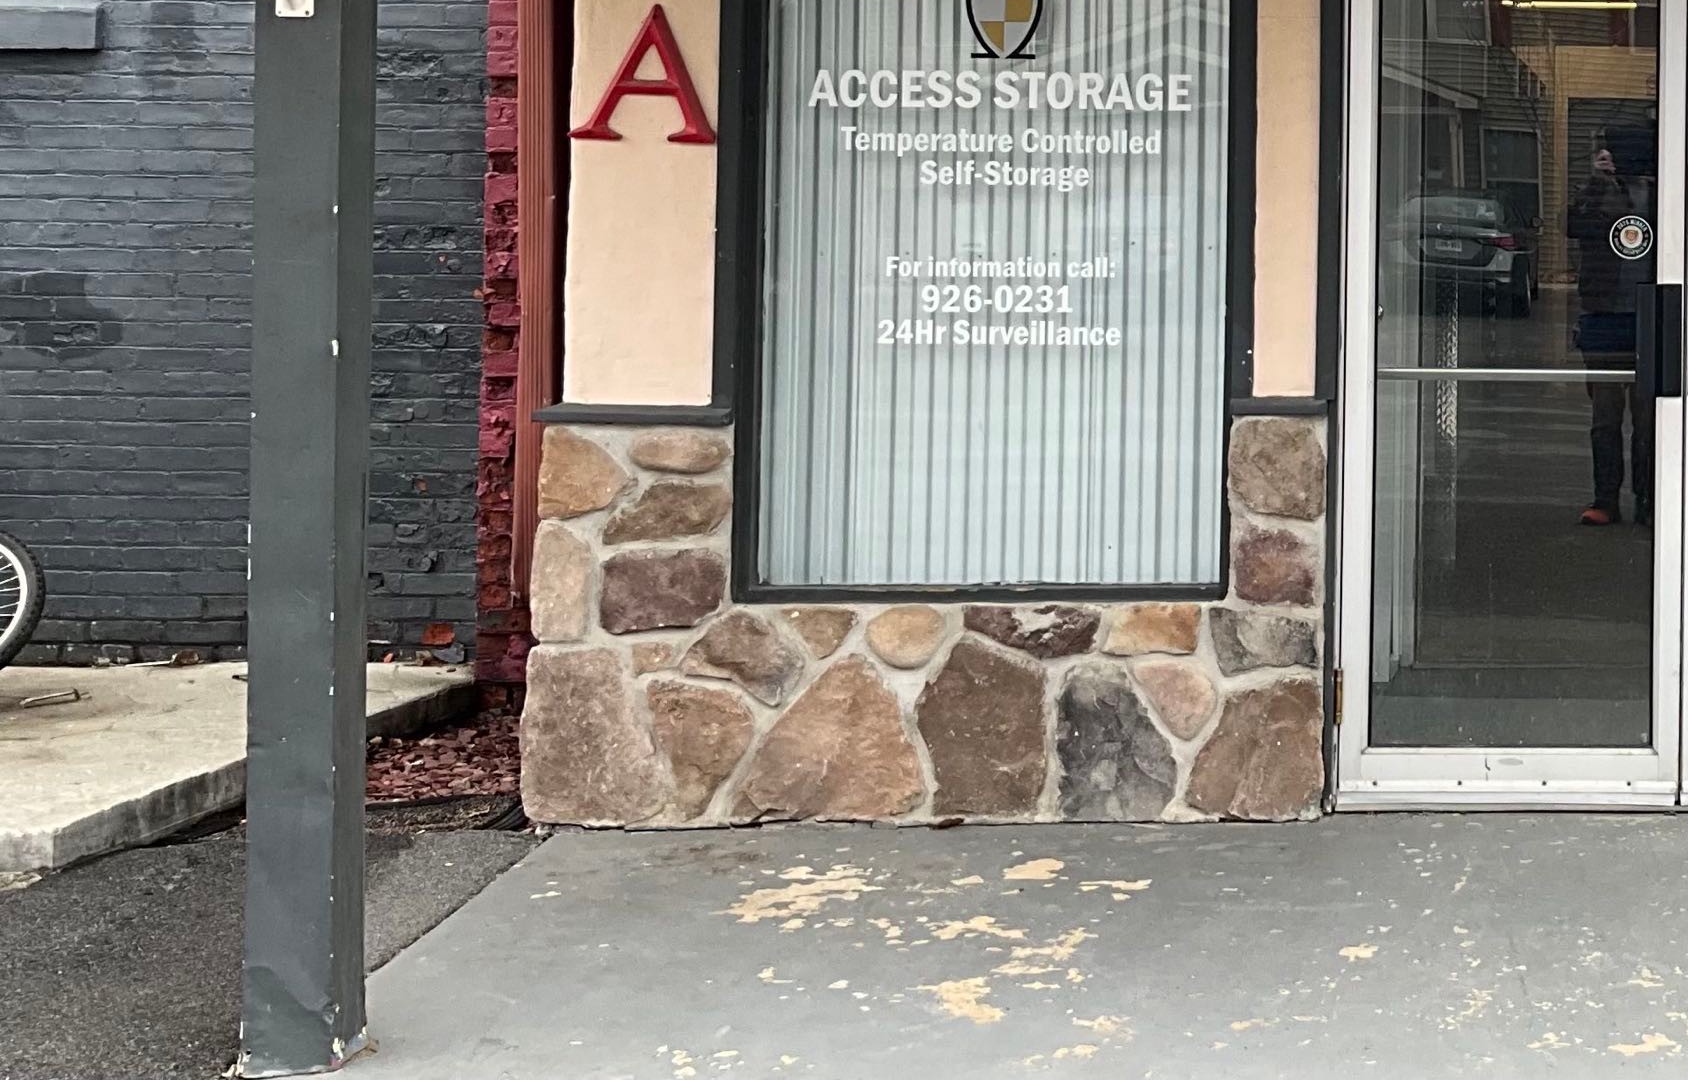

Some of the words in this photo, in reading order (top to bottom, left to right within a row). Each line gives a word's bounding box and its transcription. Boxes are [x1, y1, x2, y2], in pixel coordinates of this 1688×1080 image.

[567, 4, 716, 144] A
[808, 69, 982, 108] ACCESS
[993, 71, 1193, 112] STORAGE
[840, 126, 1014, 157] Temperature
[1021, 128, 1161, 154] Controlled
[919, 160, 1090, 191] Self-Storage
[885, 257, 921, 277] For
[927, 256, 1061, 278] information
[1066, 257, 1116, 279] call:
[921, 284, 1073, 313] 926-0231
[877, 320, 947, 345] 24Hr
[953, 321, 1121, 345] Surveillance
